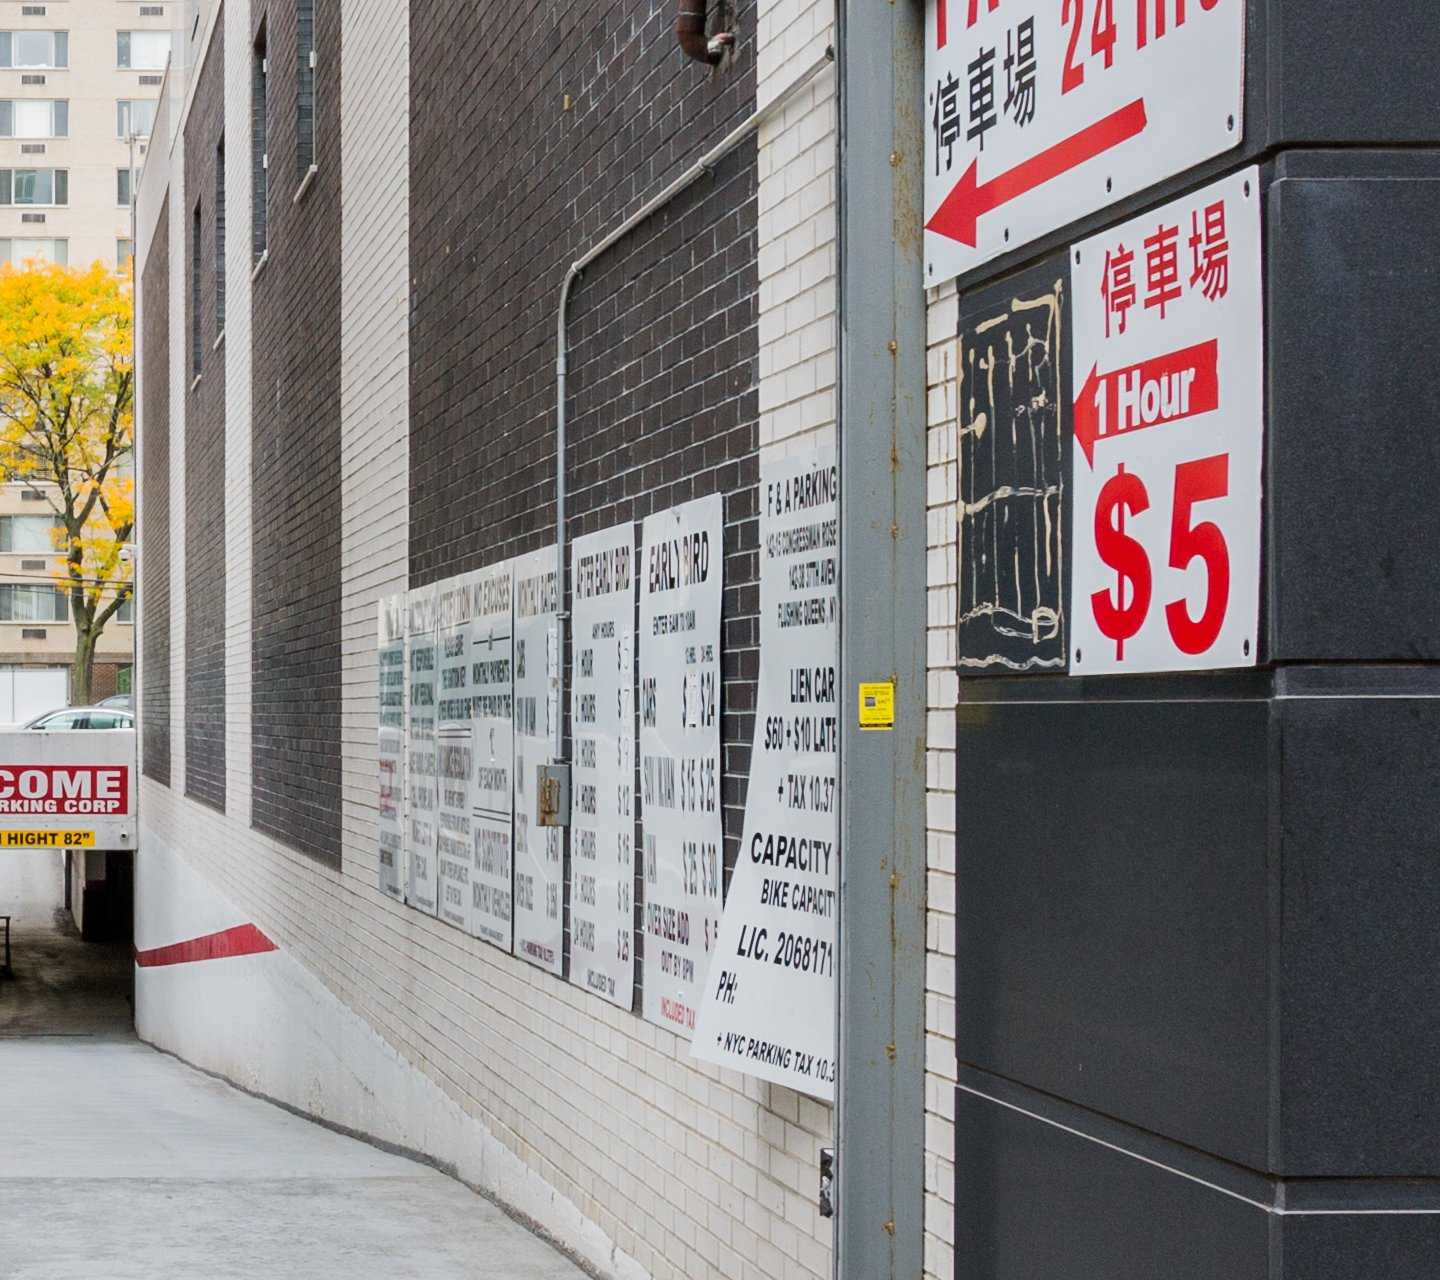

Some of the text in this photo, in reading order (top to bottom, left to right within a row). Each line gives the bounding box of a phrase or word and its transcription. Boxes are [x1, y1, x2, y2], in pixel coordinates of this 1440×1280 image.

[930, 16, 1037, 177] 停車場
[1100, 199, 1230, 339] 停車場
[1093, 366, 1195, 436] 1 Hour
[767, 466, 837, 518] F & A PARKING
[576, 545, 630, 600] AFTER EARLY BIRD
[649, 531, 709, 593] EARLY BIRD
[1090, 452, 1230, 662] $5
[790, 667, 835, 703] LIEN CAR
[813, 716, 837, 753] LATE
[64, 798, 121, 813] CORP
[787, 774, 806, 810] TAX
[7, 832, 58, 846] HIGHT
[750, 832, 832, 875] CAPACITY
[761, 878, 789, 910] BIKE
[736, 924, 769, 962] LIC.
[716, 971, 737, 1005] PH:
[723, 1032, 747, 1056] NYC
[747, 1037, 791, 1070] PARKING
[793, 1051, 812, 1076] TAX
